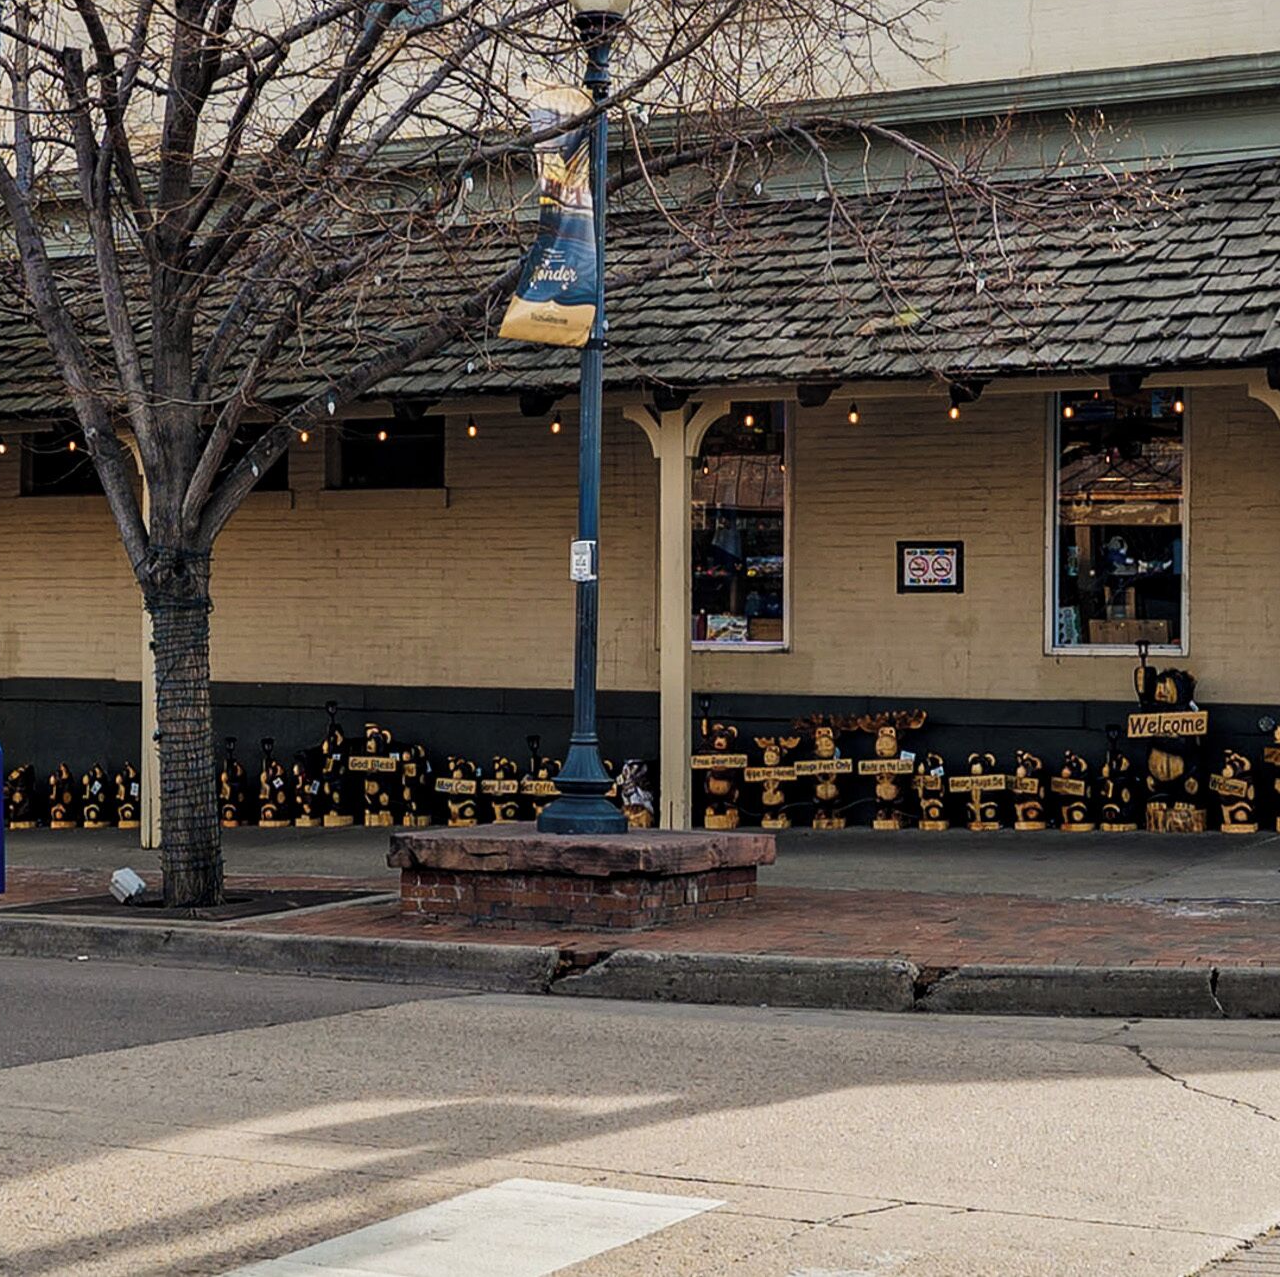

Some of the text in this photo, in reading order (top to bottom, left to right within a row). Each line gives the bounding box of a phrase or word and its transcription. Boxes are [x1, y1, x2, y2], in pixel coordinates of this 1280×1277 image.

[1130, 715, 1206, 736] Welcome
[351, 758, 369, 769] God
[372, 758, 394, 770] Bless
